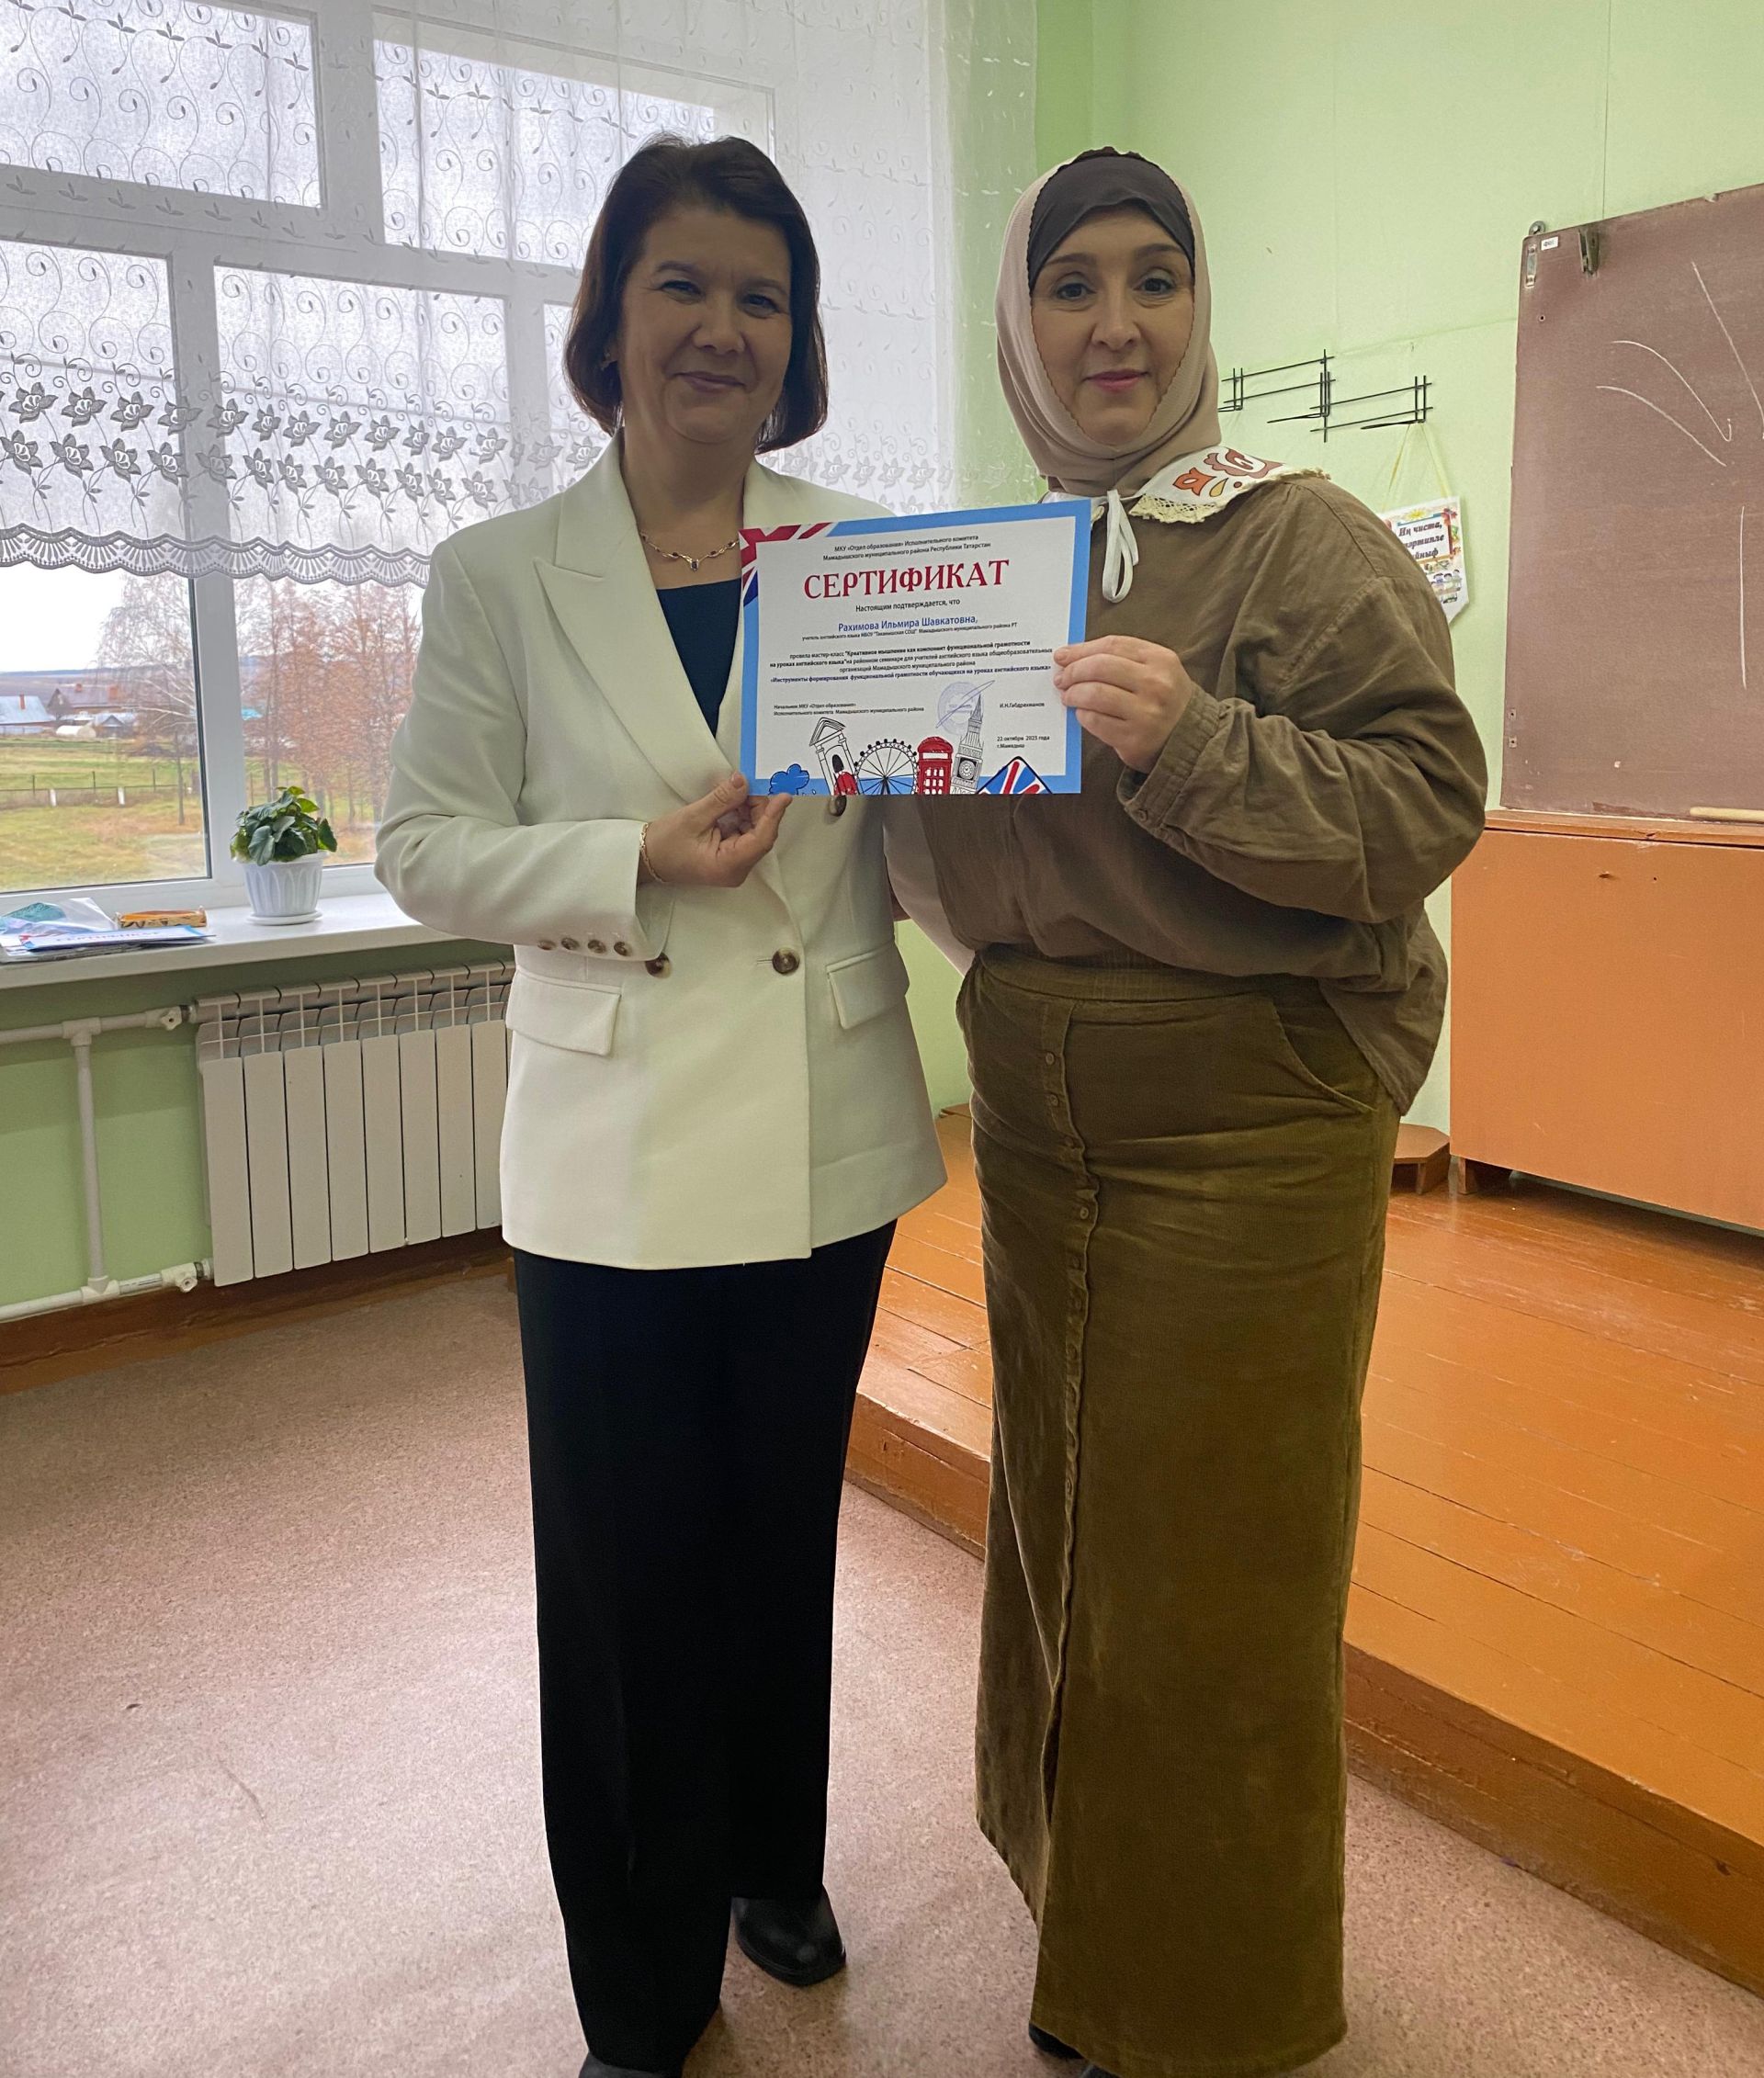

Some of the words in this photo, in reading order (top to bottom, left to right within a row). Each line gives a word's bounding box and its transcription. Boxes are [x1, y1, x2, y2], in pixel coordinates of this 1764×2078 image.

[1413, 522, 1442, 533] чиста,
[905, 537, 952, 547] Исполнительного
[865, 549, 909, 559] муниципального
[804, 559, 1009, 599] СЕРТИФИКАТ
[893, 600, 947, 609] подтверждается,
[838, 623, 878, 632] Рахимова
[881, 620, 919, 629] Ильмира
[922, 615, 978, 627] Шавкатовна,
[954, 624, 992, 632] муниципального
[946, 642, 993, 651] функциональной
[994, 640, 1030, 649] грамотности
[989, 648, 1052, 657] общеобразовательных
[850, 672, 894, 681] функциональной
